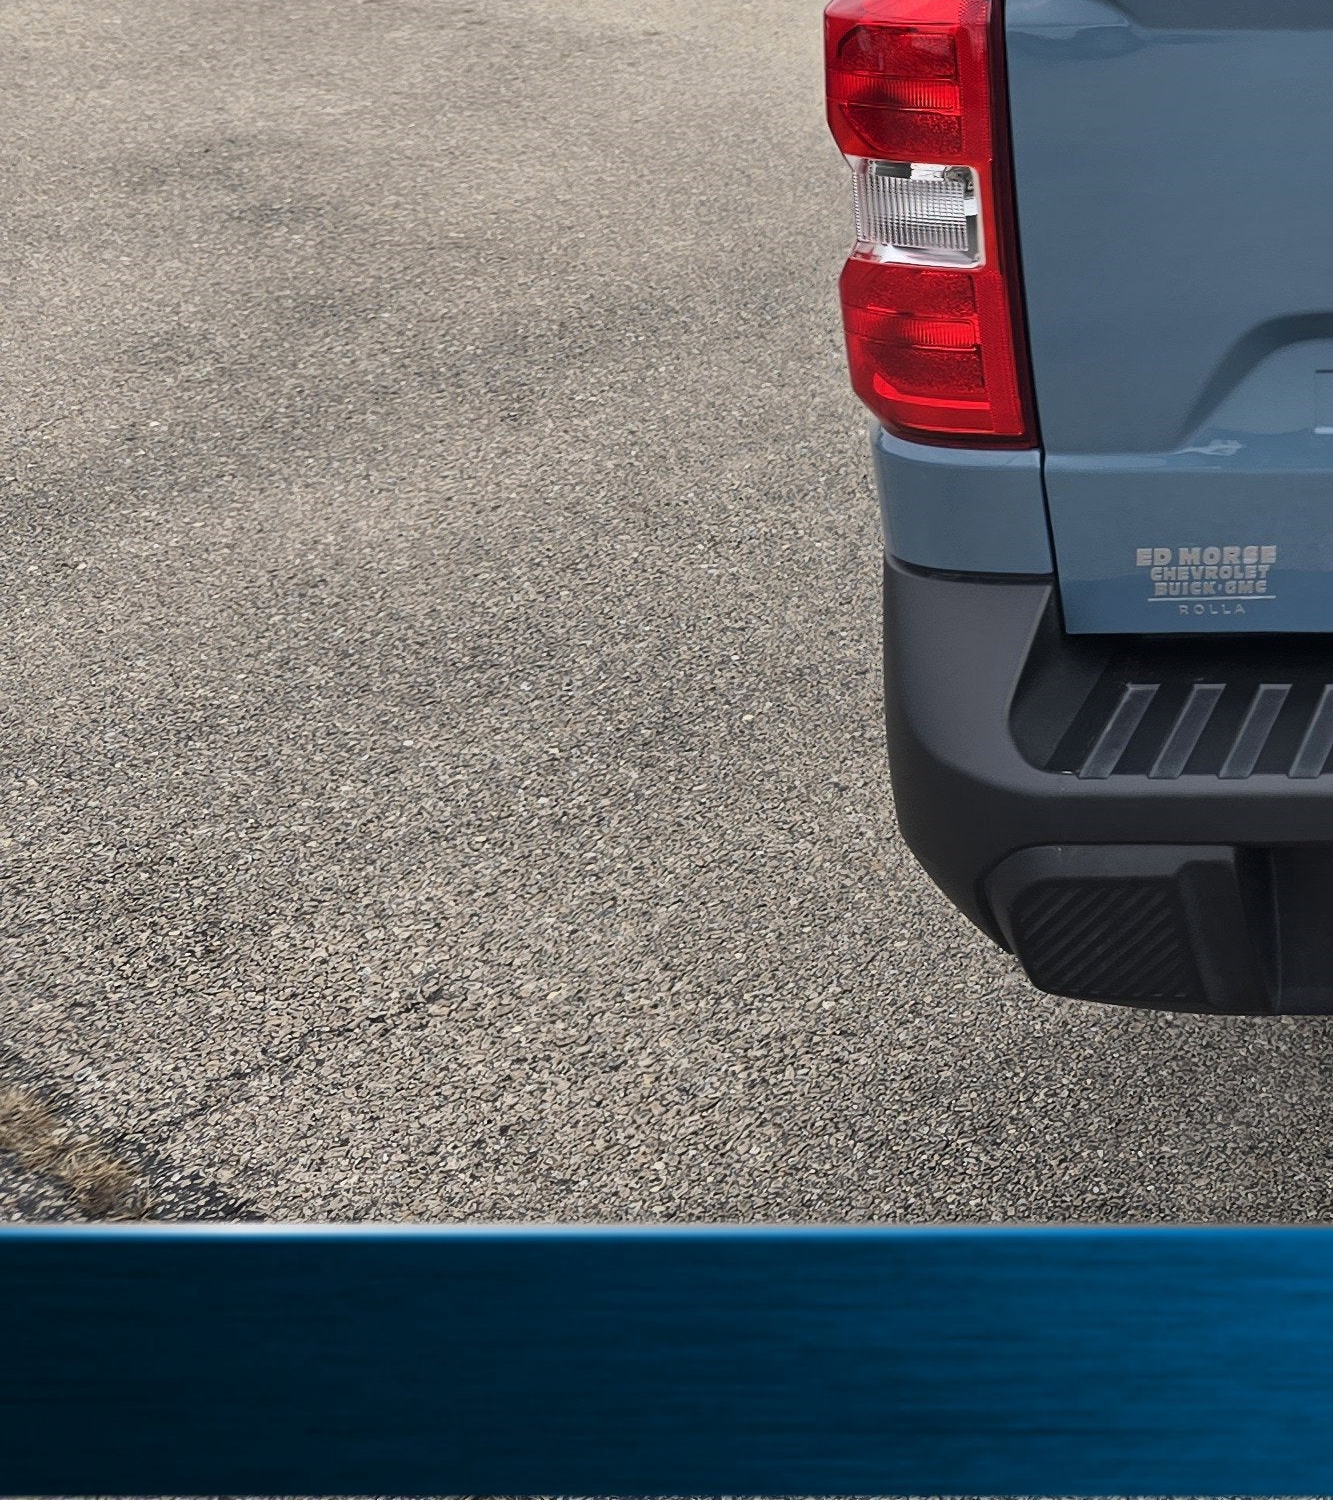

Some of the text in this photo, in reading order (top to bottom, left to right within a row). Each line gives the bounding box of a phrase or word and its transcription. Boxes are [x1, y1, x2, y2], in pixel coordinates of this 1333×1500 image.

[1136, 544, 1278, 567] ED MORSE
[1150, 564, 1271, 582] CHEVROLET
[1178, 602, 1247, 616] ROLLA
